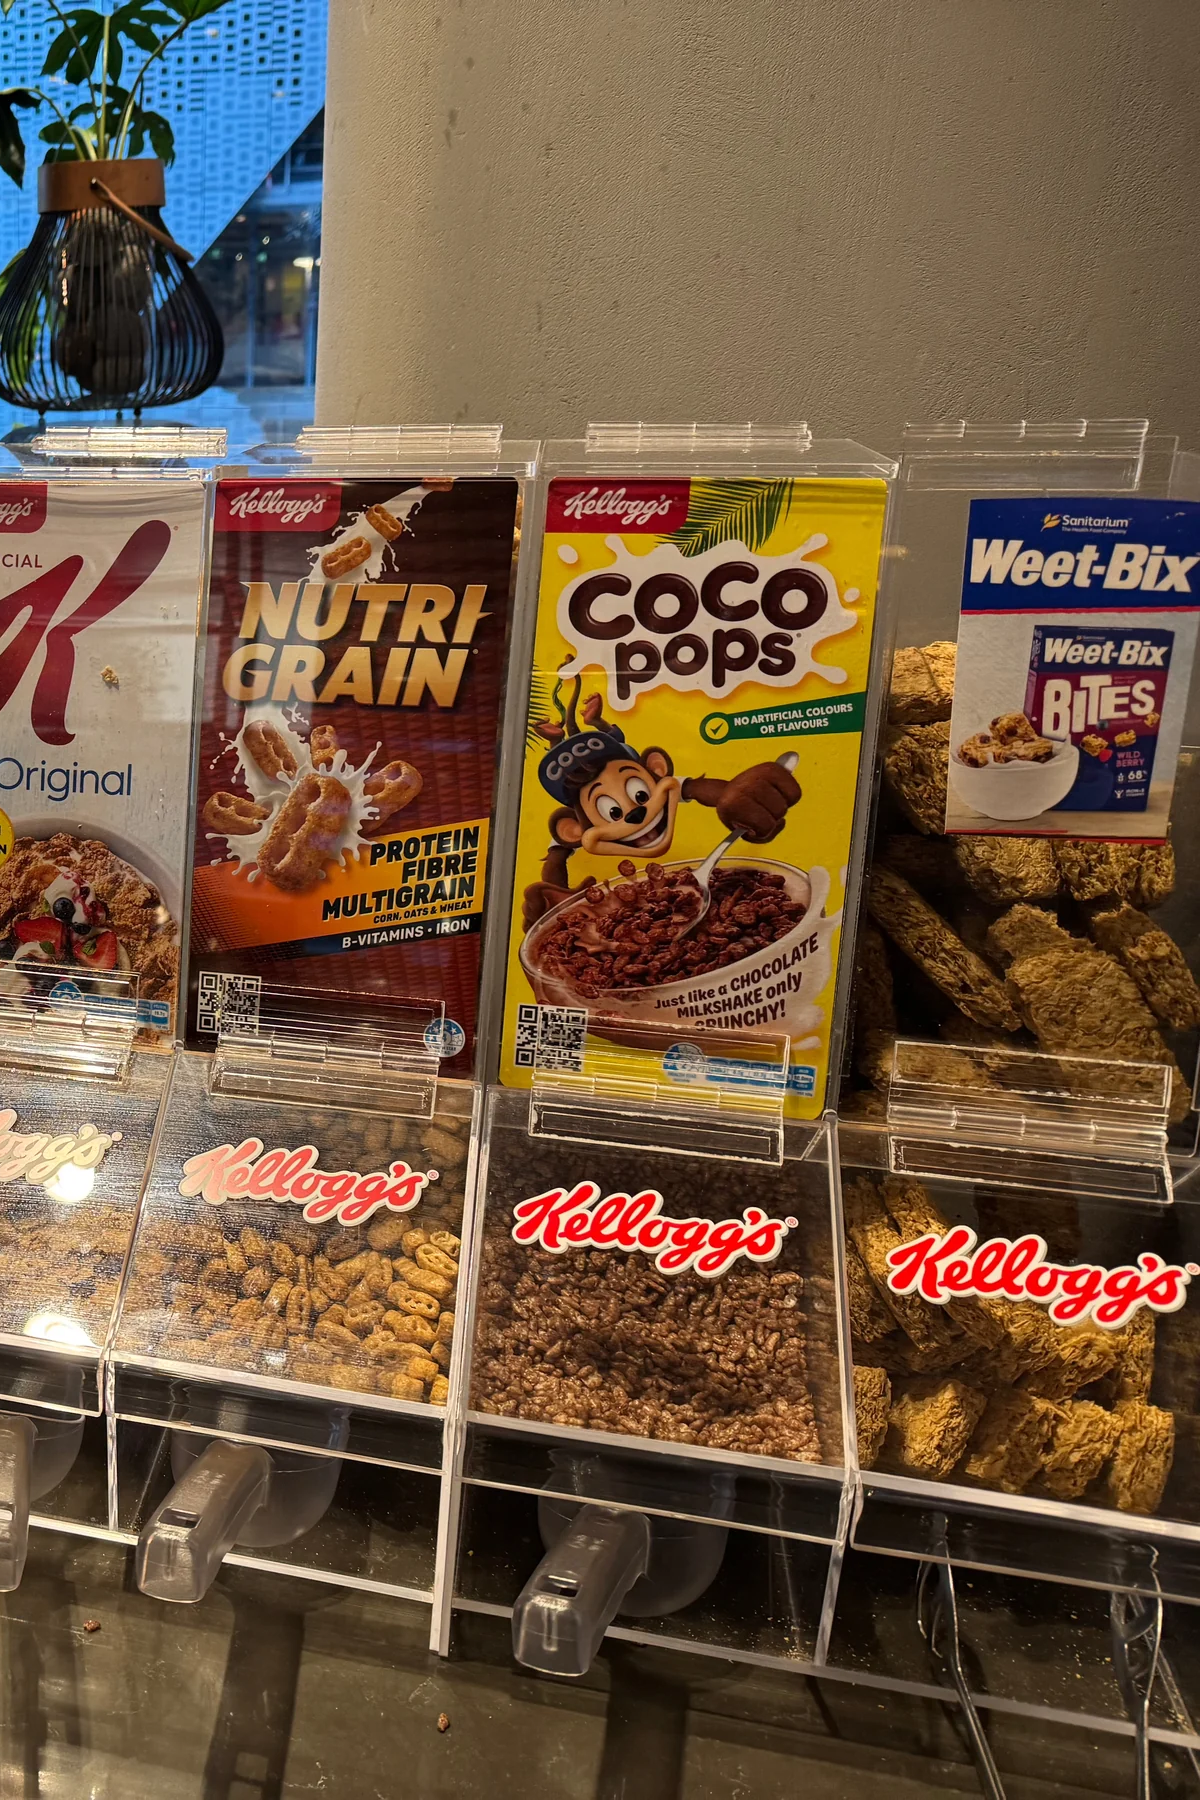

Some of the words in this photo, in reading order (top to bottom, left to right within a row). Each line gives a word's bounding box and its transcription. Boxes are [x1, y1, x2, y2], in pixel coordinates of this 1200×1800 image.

[229, 487, 327, 523] Kellogg's
[563, 487, 673, 525] Kellogg's
[1062, 514, 1129, 528] Sanitarium
[969, 537, 1200, 593] Weet-Bix
[238, 581, 490, 644] NUTRI
[1043, 637, 1169, 667] Weet-Bix
[222, 643, 470, 708] GRAIN
[733, 716, 750, 726] NO
[750, 709, 804, 724] ARTIFICIAL
[805, 703, 854, 717] COLOURS
[759, 724, 776, 735] OR
[777, 717, 830, 733] FLAVOURS
[369, 825, 480, 866] PROTEIN
[401, 850, 478, 884] FIBRE
[321, 874, 476, 921] MULTIGRAIN
[403, 907, 429, 919] OATS
[430, 906, 437, 915] &
[440, 900, 473, 914] WHEAT
[341, 925, 425, 949] B-VITAMINS
[436, 918, 471, 935] IRON
[654, 994, 686, 1009] Just
[688, 988, 715, 1004] like
[718, 983, 728, 996] a
[730, 931, 819, 992] CHOCOLATE
[677, 987, 763, 1019] MILKSHAKE
[765, 971, 803, 1000] only
[183, 1139, 424, 1224] Kellogg's
[514, 1184, 785, 1270] Kellogg's
[888, 1229, 1183, 1323] Kellogg's
